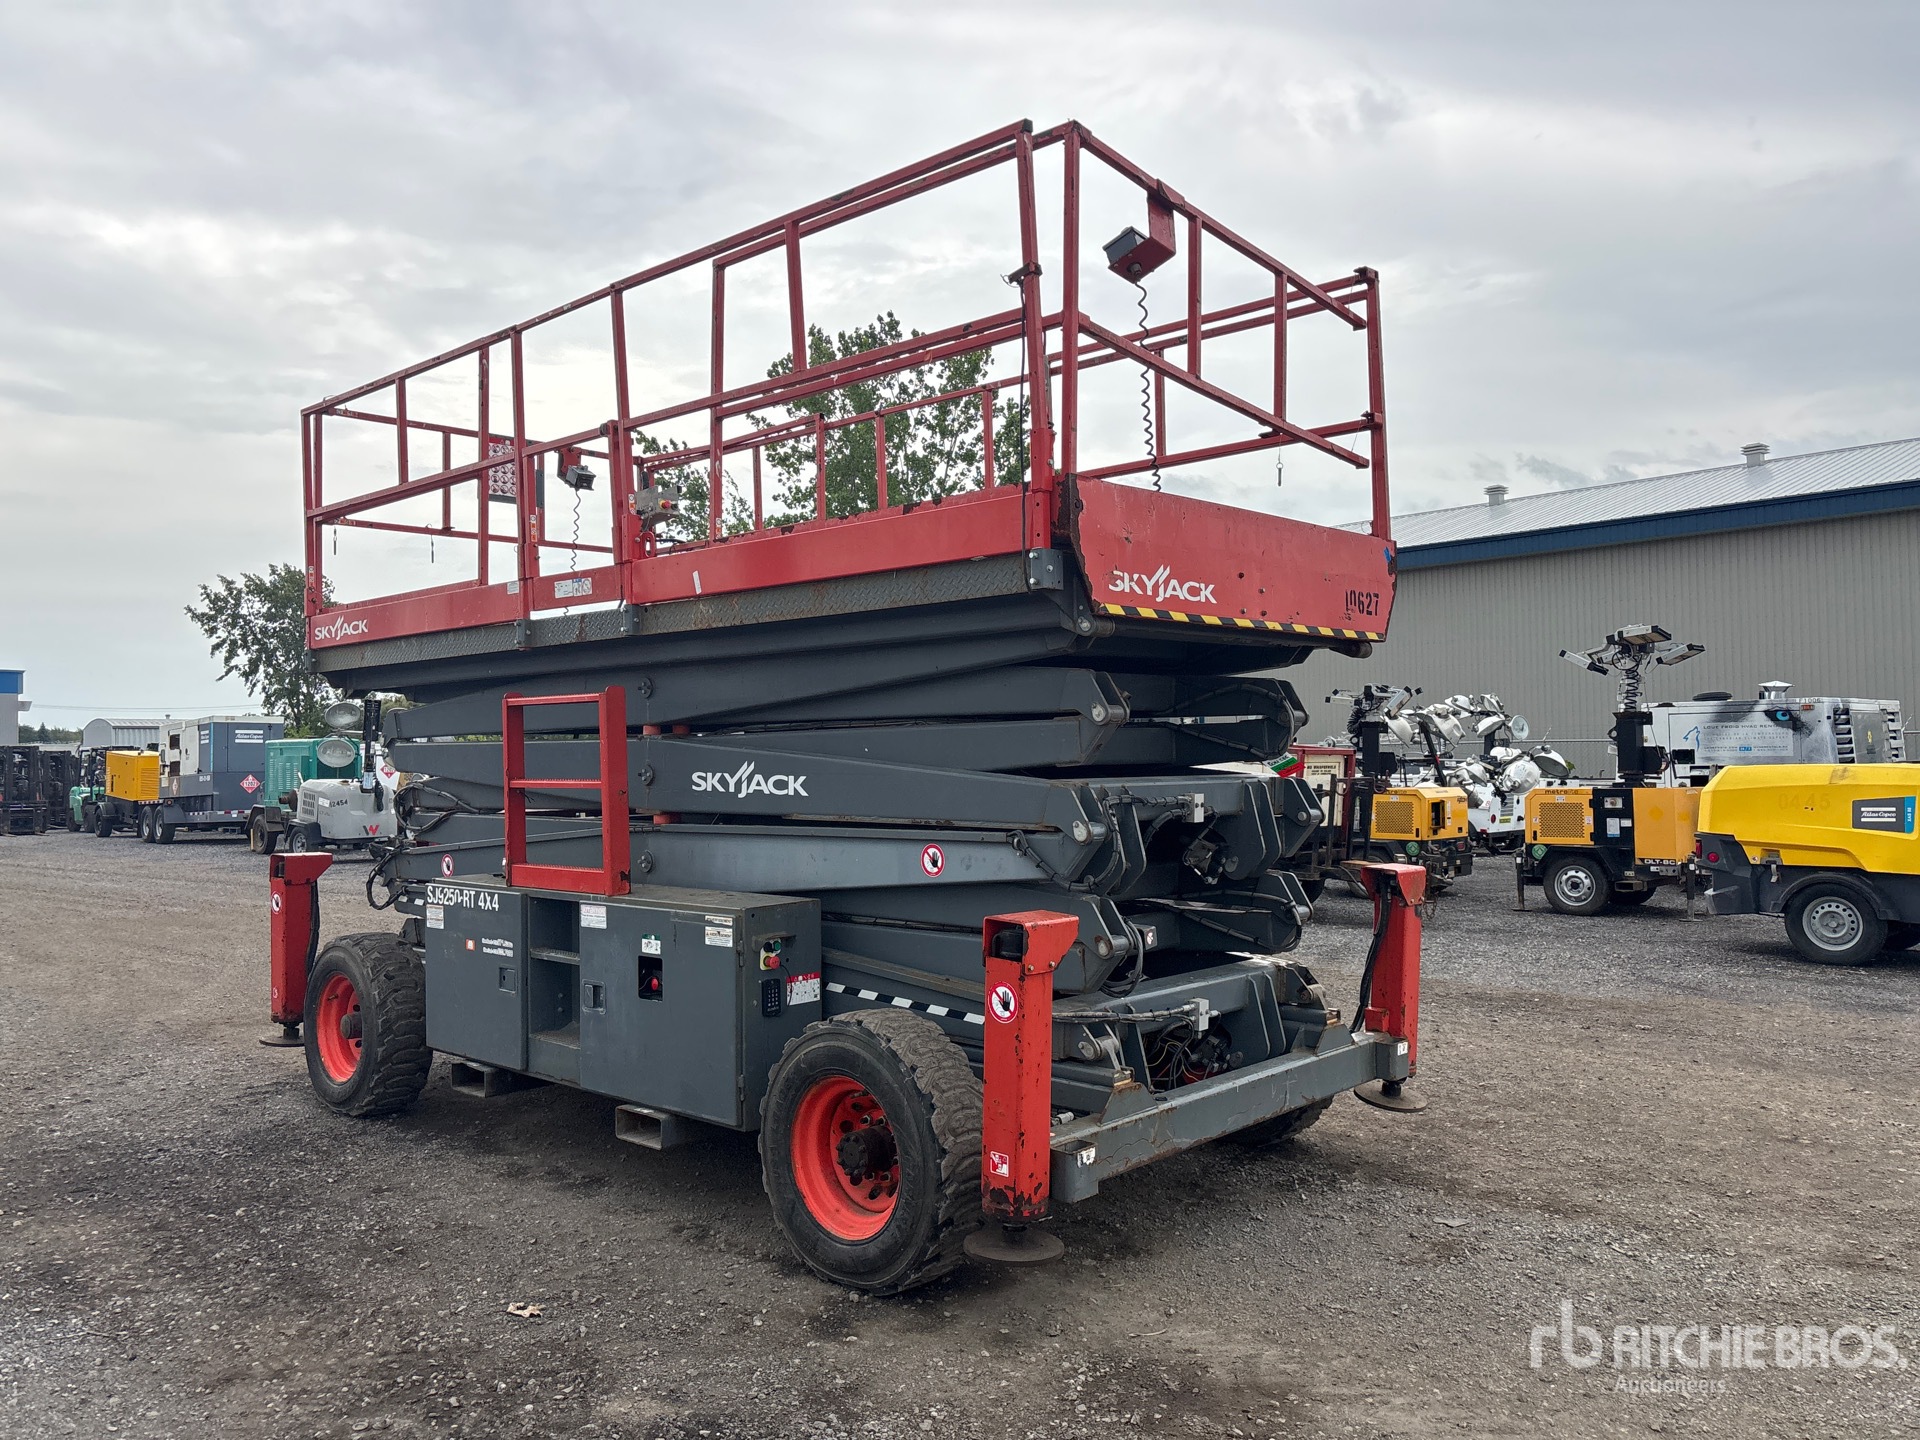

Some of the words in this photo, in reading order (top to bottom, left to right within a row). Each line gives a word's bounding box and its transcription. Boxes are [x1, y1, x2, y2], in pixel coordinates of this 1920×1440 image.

[1108, 564, 1218, 604] SKYJACK
[314, 615, 369, 641] SKYJACK
[691, 761, 809, 798] SKYJACK
